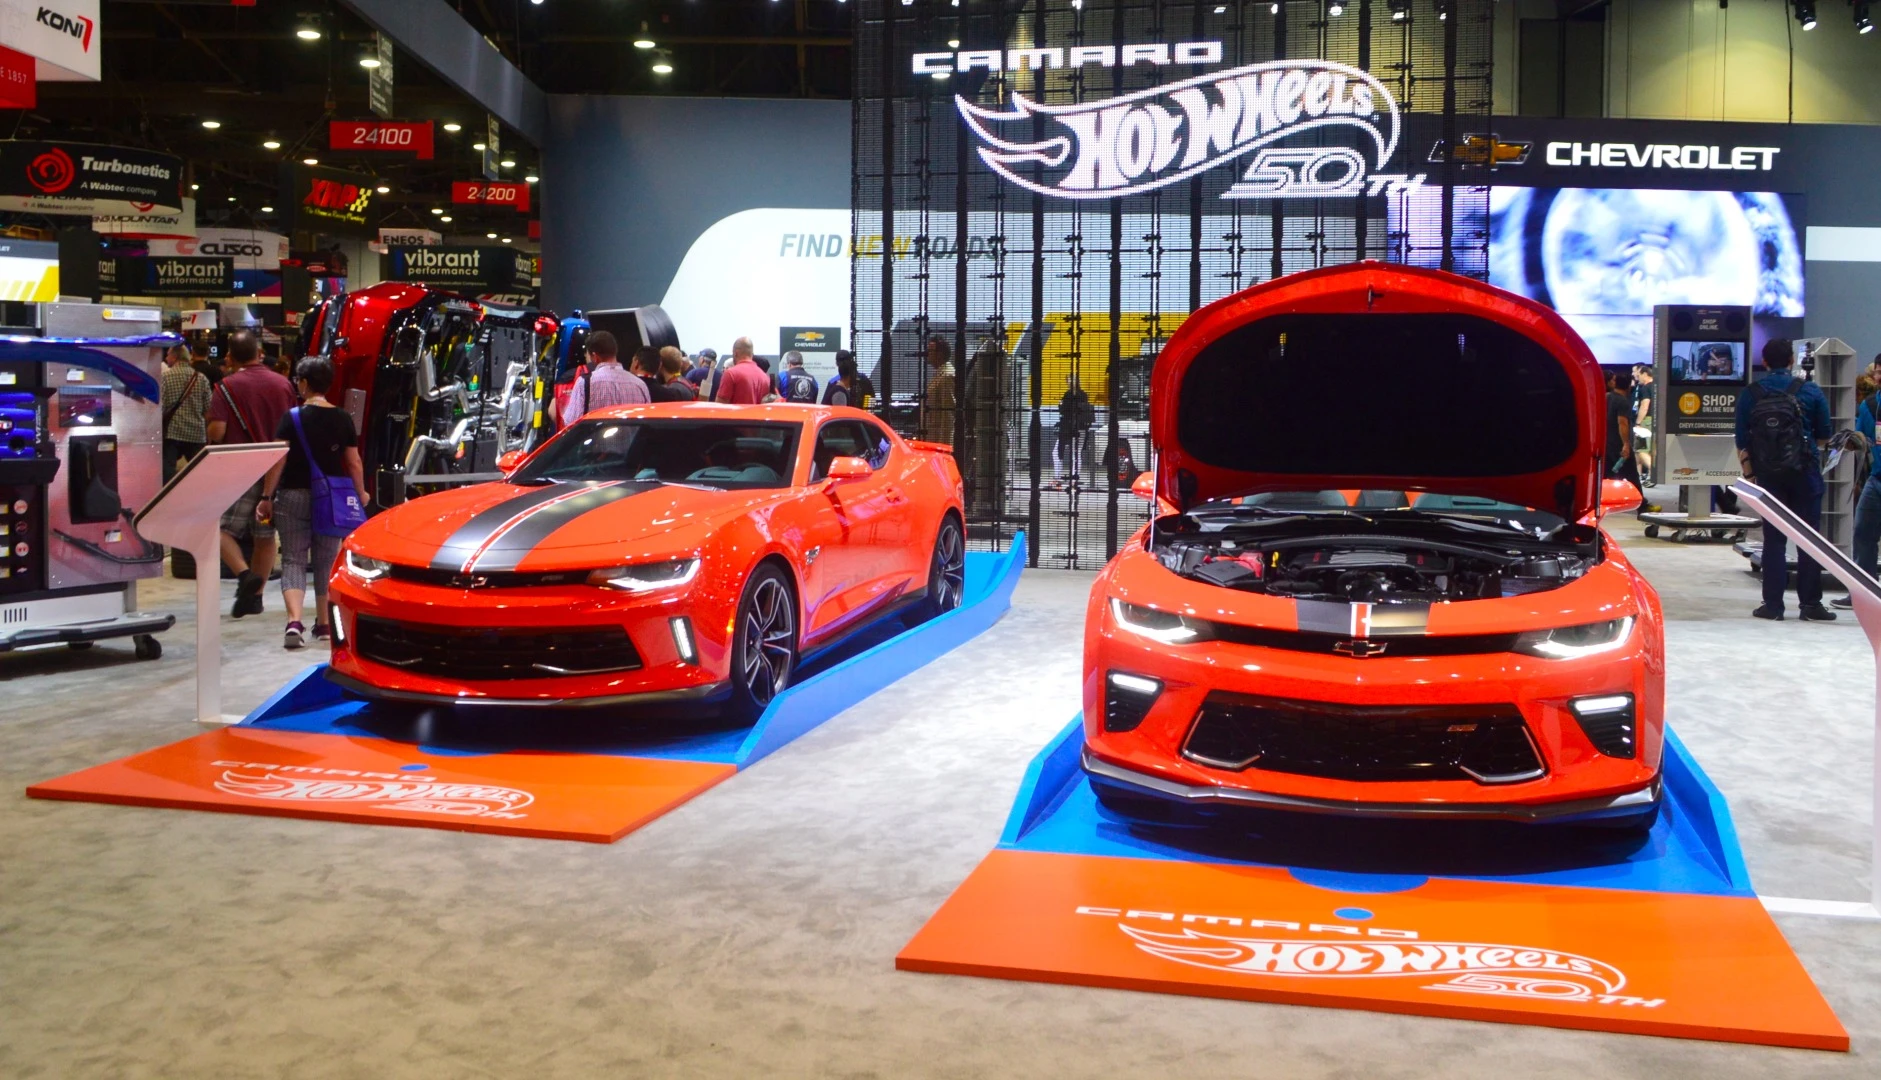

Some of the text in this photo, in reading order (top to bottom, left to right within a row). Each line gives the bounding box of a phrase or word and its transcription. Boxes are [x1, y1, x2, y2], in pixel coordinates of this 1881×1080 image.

[912, 40, 1223, 75] CAMARO
[7, 68, 28, 85] 1857
[353, 127, 412, 145] 24100
[1546, 141, 1780, 171] CHEVROLET
[81, 156, 170, 180] Turbonetics
[80, 181, 157, 197] A Wabtec company
[303, 178, 358, 209] XRP
[467, 186, 516, 201] 24200
[112, 215, 179, 227] MOUNTAIN
[383, 236, 424, 245] ENEOS
[780, 233, 843, 258] FIND
[847, 234, 911, 260] NEW
[200, 243, 263, 257] CUSCO
[405, 249, 480, 267] vibrant
[156, 261, 225, 277] vibrant
[408, 267, 478, 276] performance
[159, 277, 224, 285] performance
[1702, 395, 1736, 407] SHOP
[210, 760, 437, 782] CAMARO
[1075, 905, 1419, 940] CAMARO
